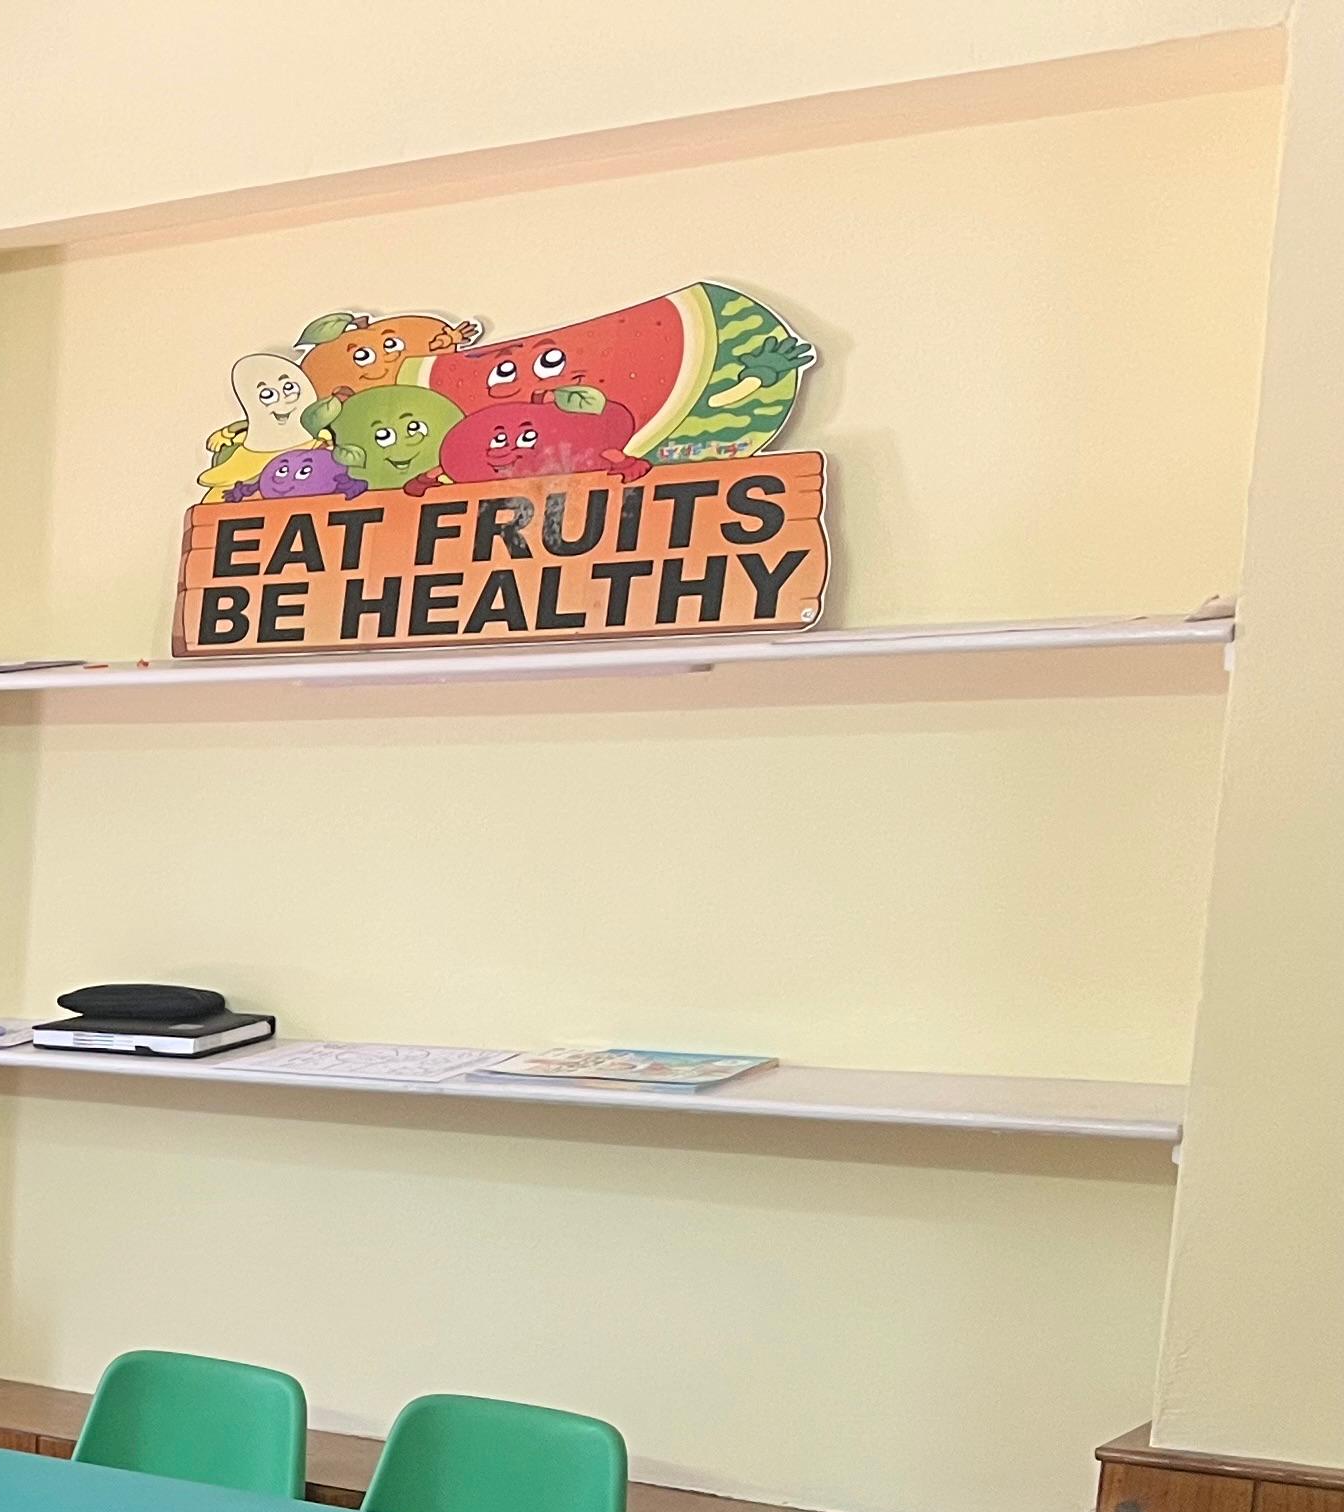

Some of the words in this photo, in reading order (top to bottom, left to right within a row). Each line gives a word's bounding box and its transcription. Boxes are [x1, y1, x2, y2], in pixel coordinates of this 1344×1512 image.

[211, 507, 384, 579] EAT
[413, 474, 788, 566] FRUITS
[195, 581, 308, 646] BE
[338, 547, 811, 640] HEALTHY
